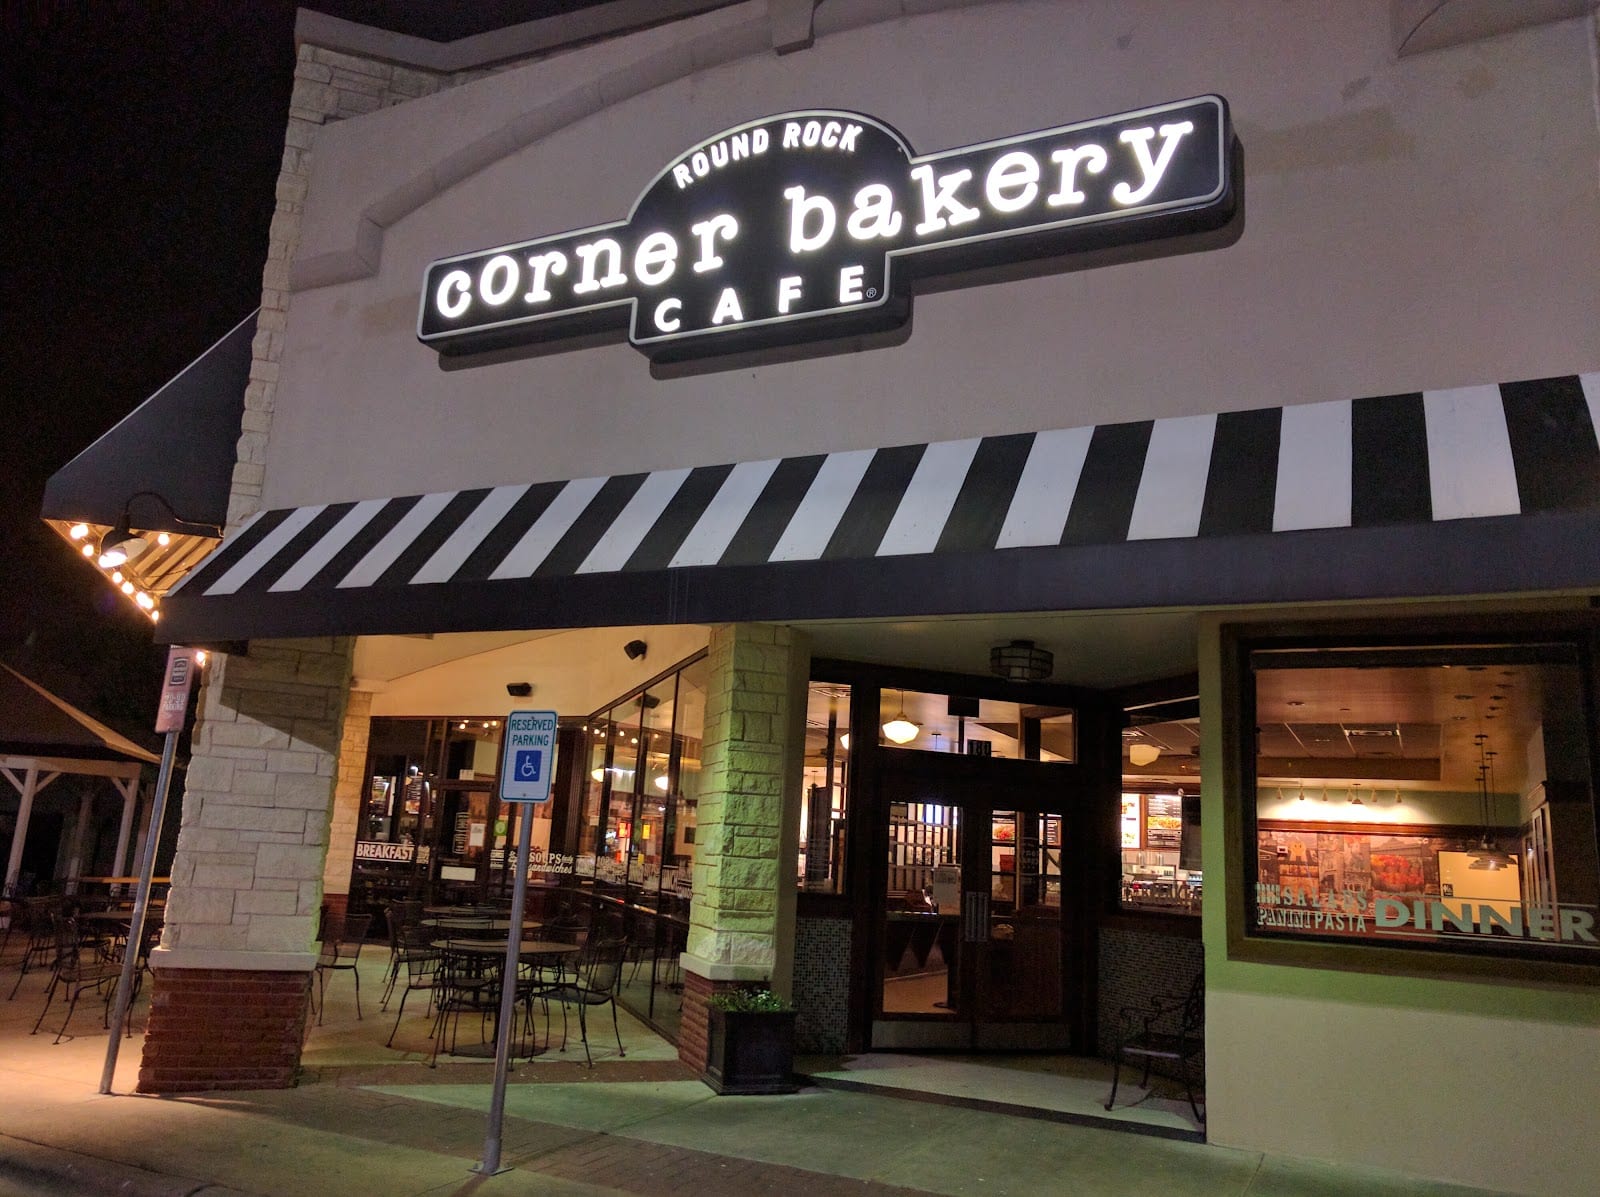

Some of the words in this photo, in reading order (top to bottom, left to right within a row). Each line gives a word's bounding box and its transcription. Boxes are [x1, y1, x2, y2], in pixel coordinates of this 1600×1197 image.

[673, 128, 769, 189] ROUND
[783, 121, 863, 152] ROCK
[436, 213, 739, 319] corner
[784, 121, 1194, 254] bakery
[654, 265, 865, 332] CAFE
[511, 719, 554, 731] RESERVED
[512, 734, 550, 746] PARKING
[356, 843, 415, 861] BREAKFAST
[529, 851, 562, 864] SOUPS
[1283, 886, 1367, 911] SALADS
[1257, 906, 1311, 929] PANINI
[1314, 911, 1367, 933] PASTA
[1375, 898, 1598, 942] DINNER
